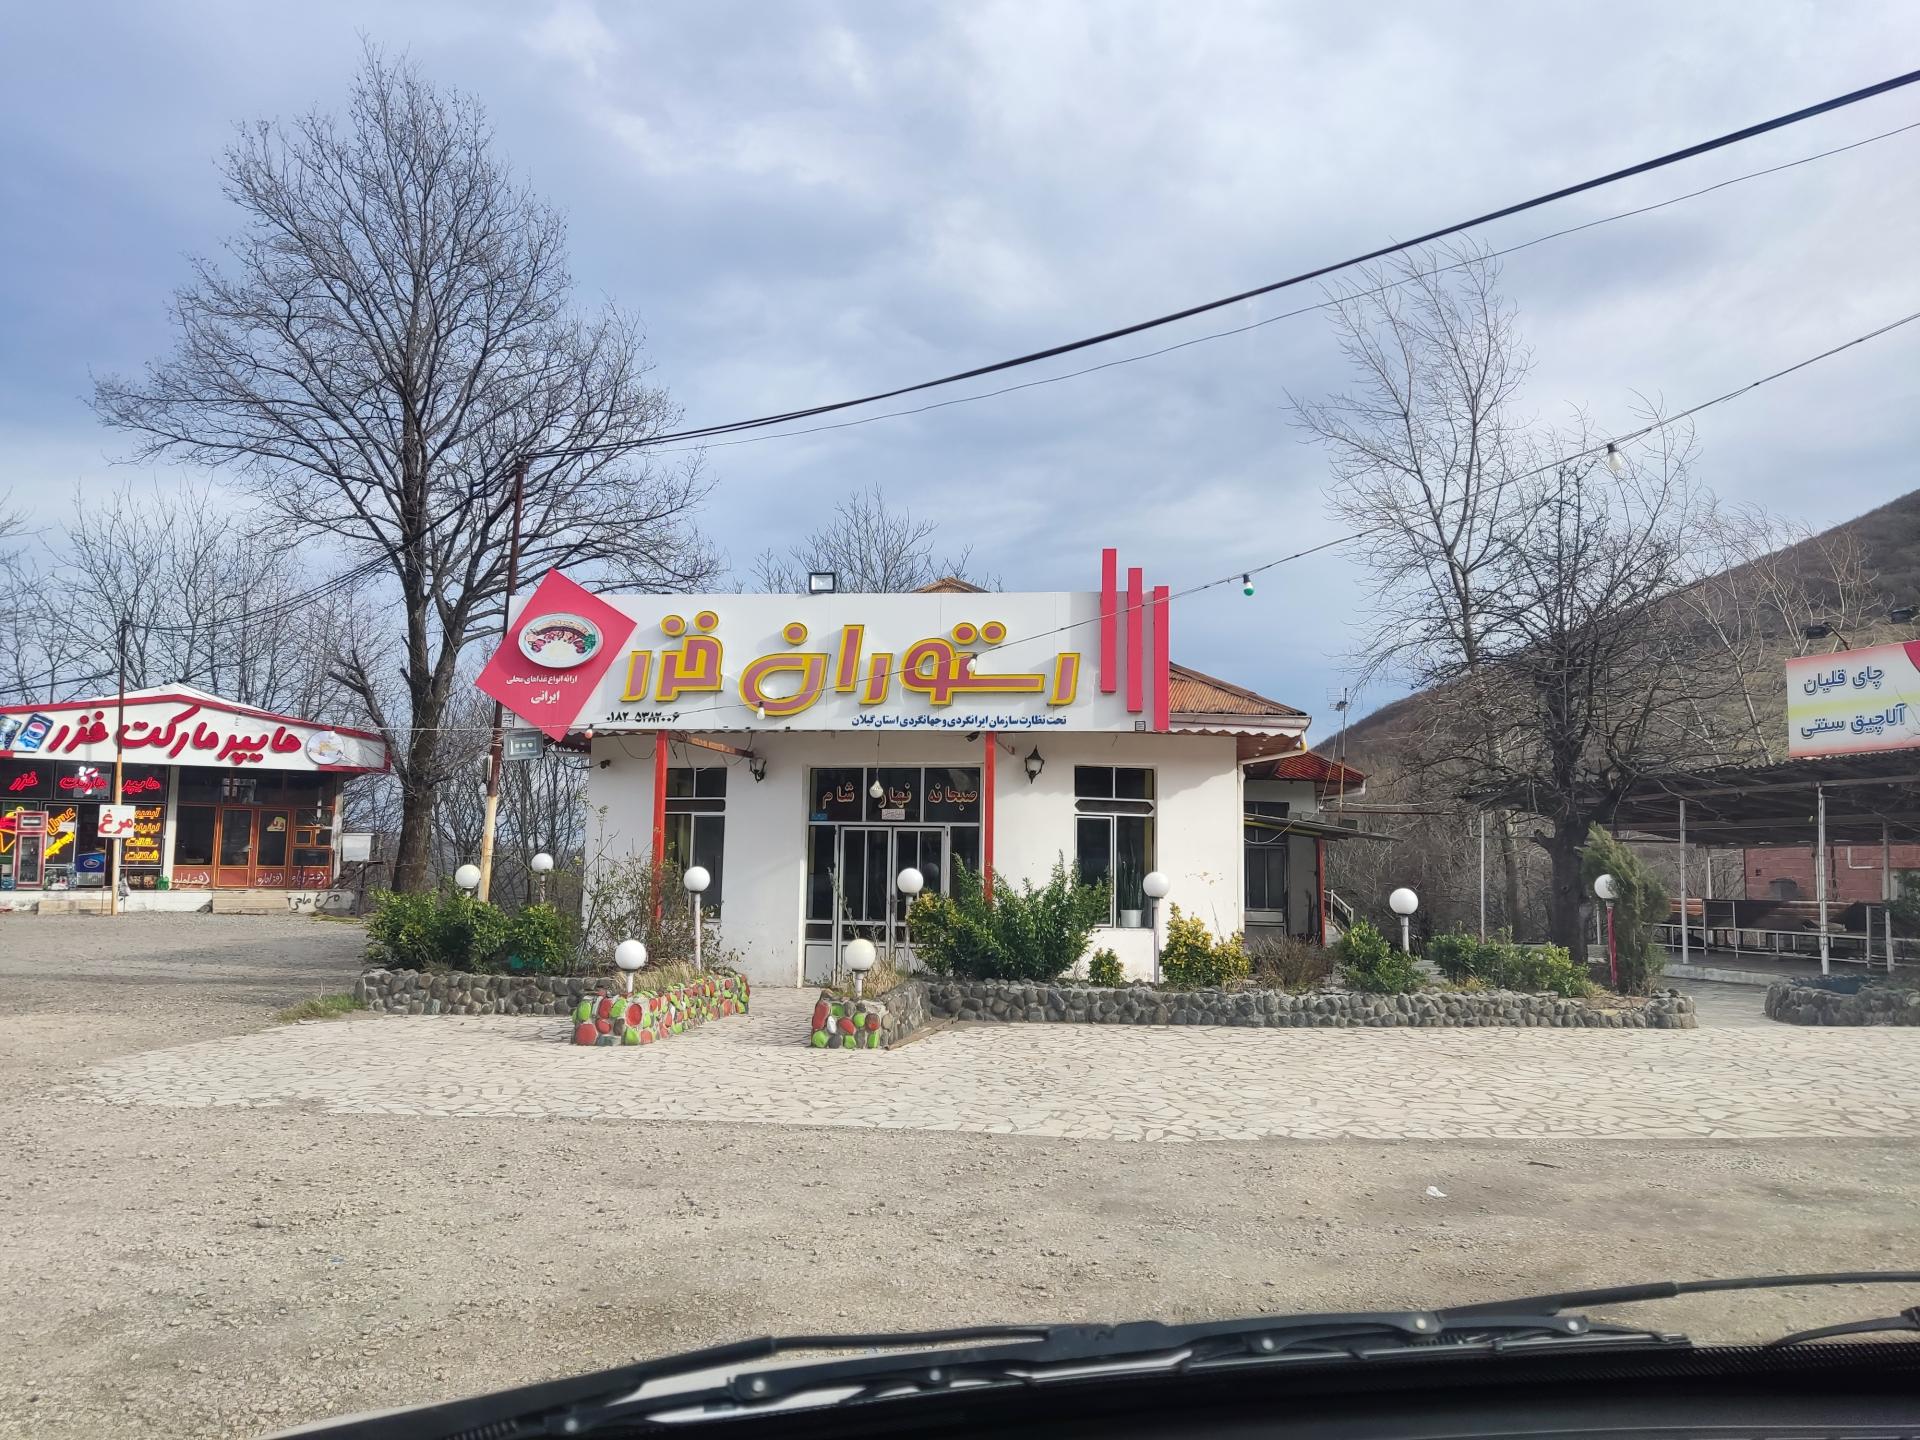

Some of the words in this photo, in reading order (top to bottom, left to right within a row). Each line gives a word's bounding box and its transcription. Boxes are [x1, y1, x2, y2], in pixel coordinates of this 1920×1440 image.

[618, 610, 724, 703] خزر
[738, 620, 1081, 717] رستوران
[1852, 665, 1885, 688] چای
[506, 674, 524, 685] محلی
[524, 674, 548, 685] غذاهای
[547, 674, 563, 685] انواع
[1803, 668, 1847, 695] قلیان
[530, 689, 561, 704] ایرانی
[851, 714, 875, 727] گیلان
[874, 714, 900, 728] استان
[900, 714, 942, 728] جهانگردی
[942, 719, 947, 727] و
[947, 714, 989, 729] ایرانگردی
[988, 715, 1019, 729] سازمان
[1019, 714, 1046, 729] نظارت
[1046, 715, 1067, 726] تحت
[1801, 717, 1846, 739] سنتی
[1851, 702, 1907, 735] آلاچیق
[48, 710, 109, 753] خزر
[118, 704, 219, 759] مارکت
[217, 724, 302, 766] هایپر
[9, 771, 39, 791] خزر
[60, 767, 107, 795] مارکت
[121, 776, 161, 795] هایپر
[822, 781, 855, 810] شام
[877, 782, 912, 809] نهار
[927, 782, 978, 811] صبحانه
[98, 808, 134, 835] مرغ
